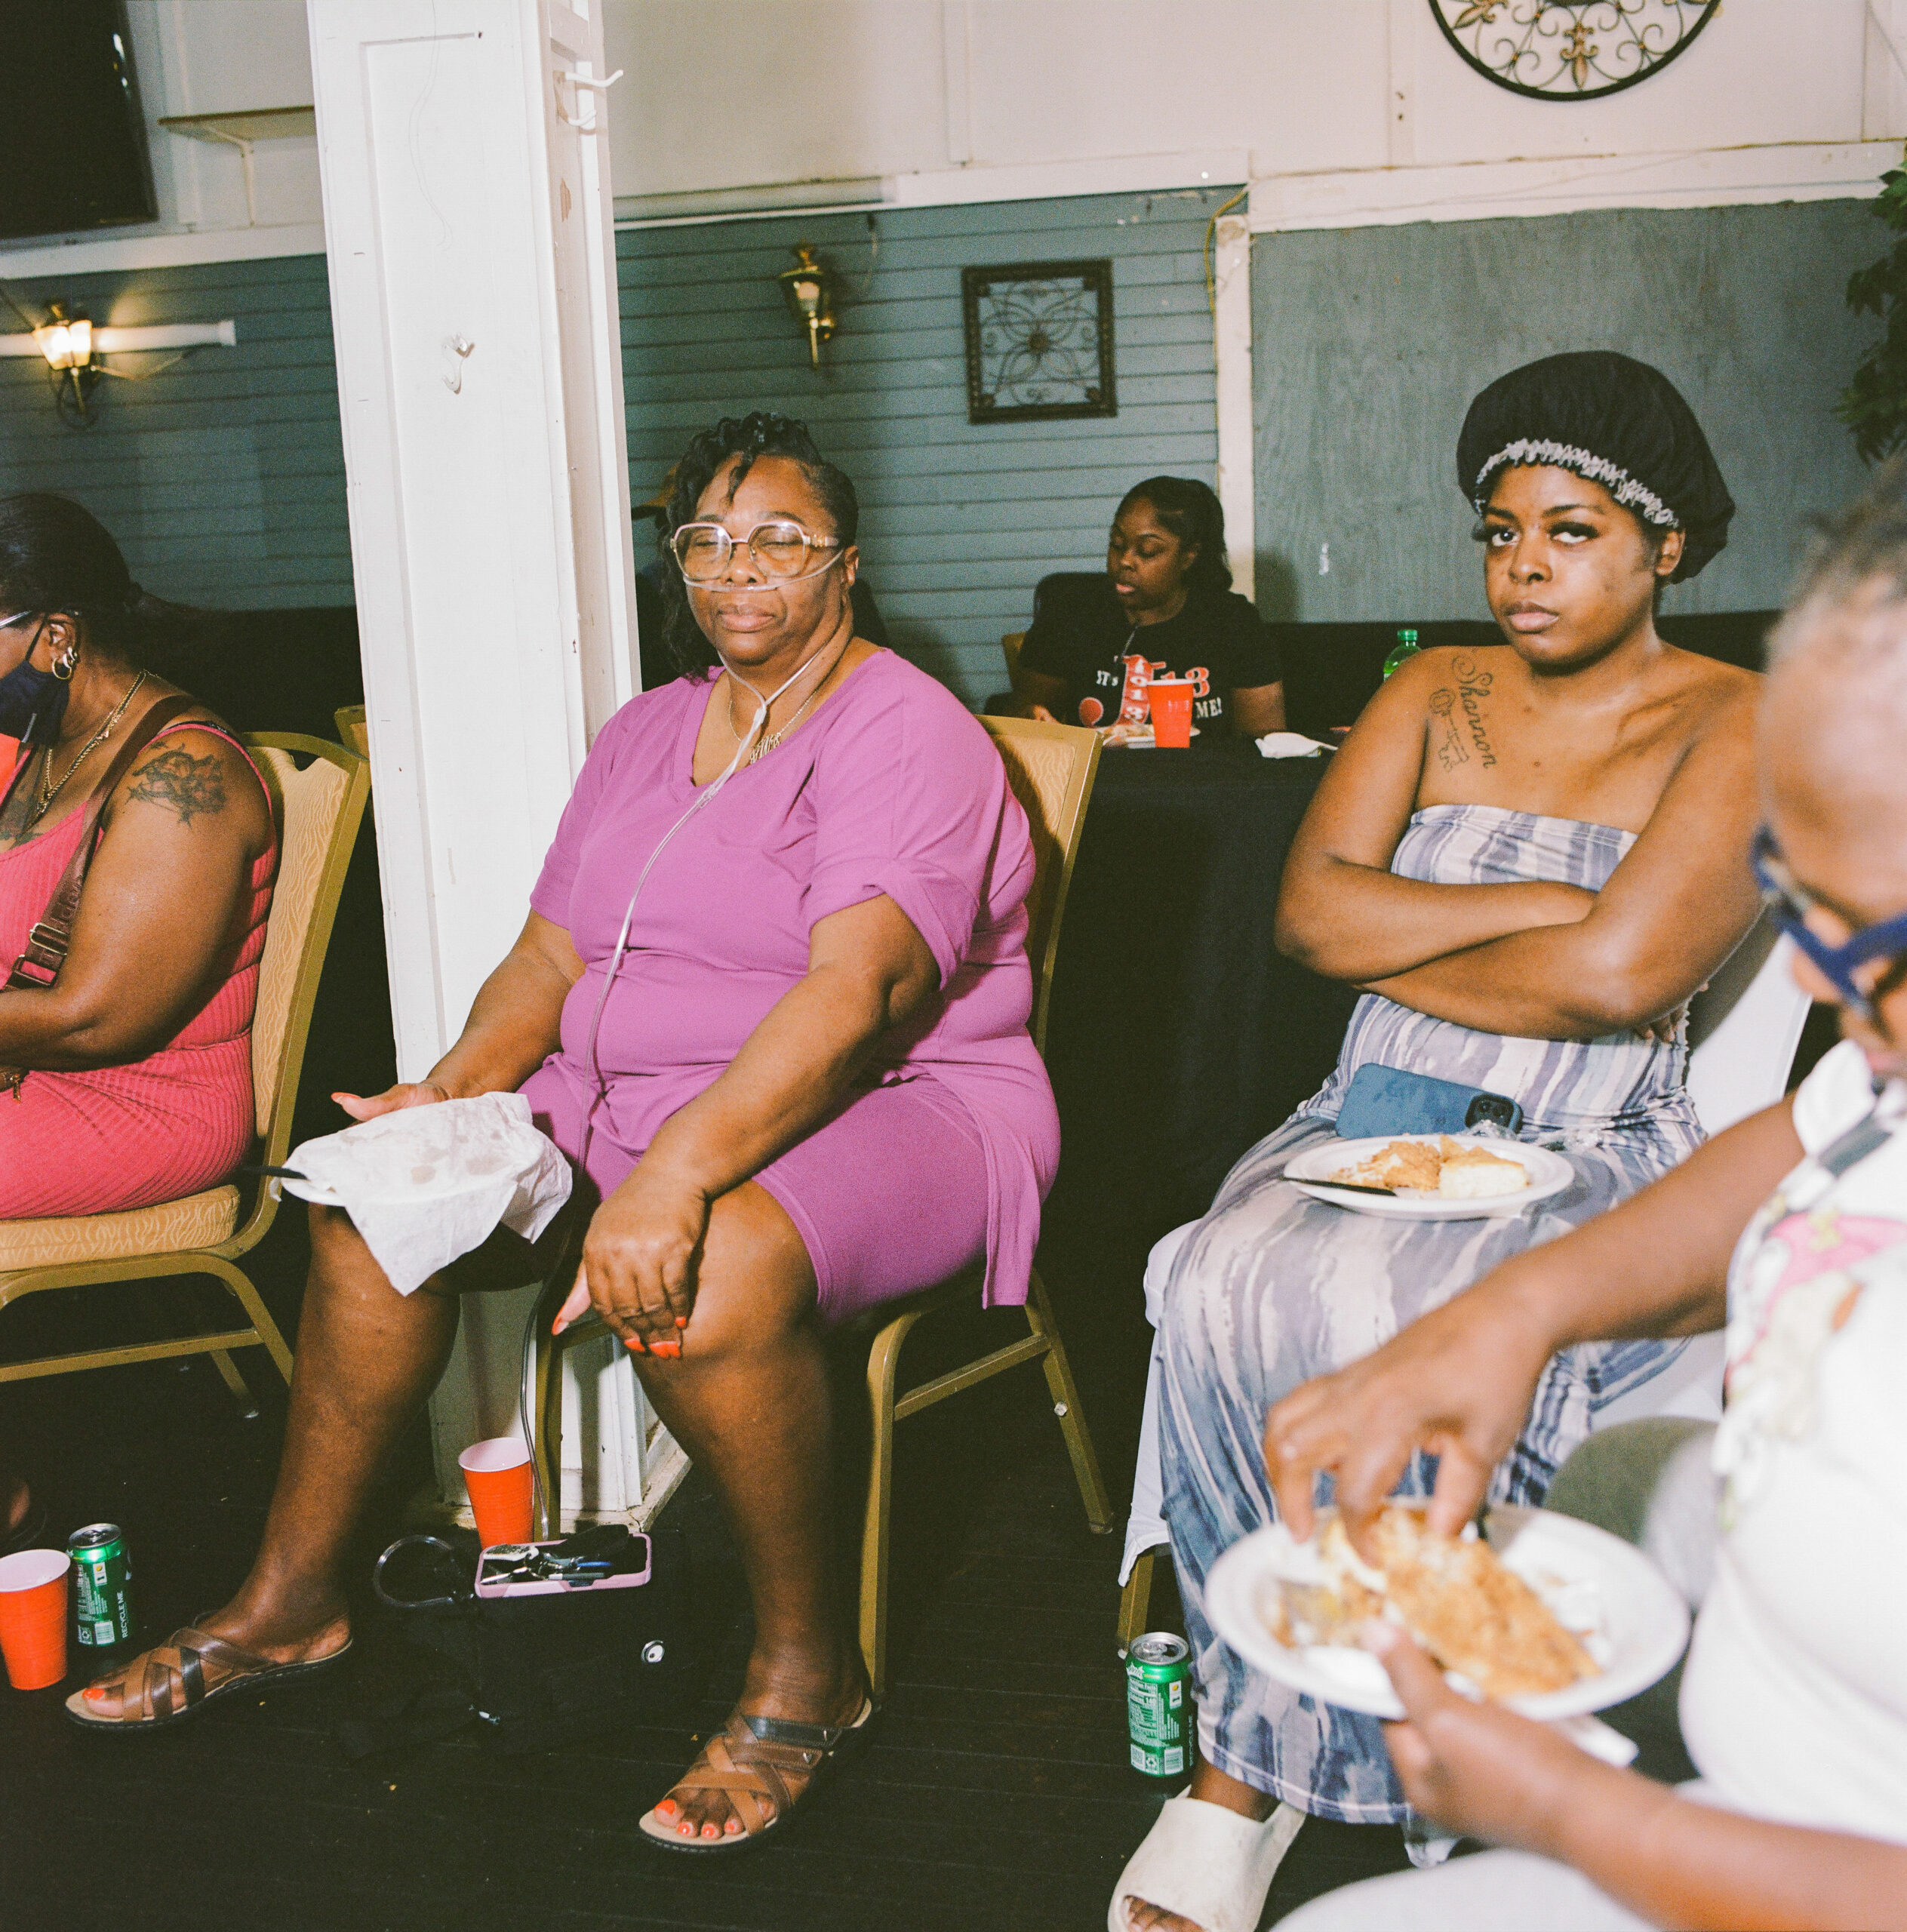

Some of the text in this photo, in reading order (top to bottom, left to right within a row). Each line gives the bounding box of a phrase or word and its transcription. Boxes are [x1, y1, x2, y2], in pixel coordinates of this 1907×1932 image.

[1450, 655, 1496, 769] Shannon
[116, 1590, 124, 1604] ME
[118, 1603, 128, 1638] RECYCLE
